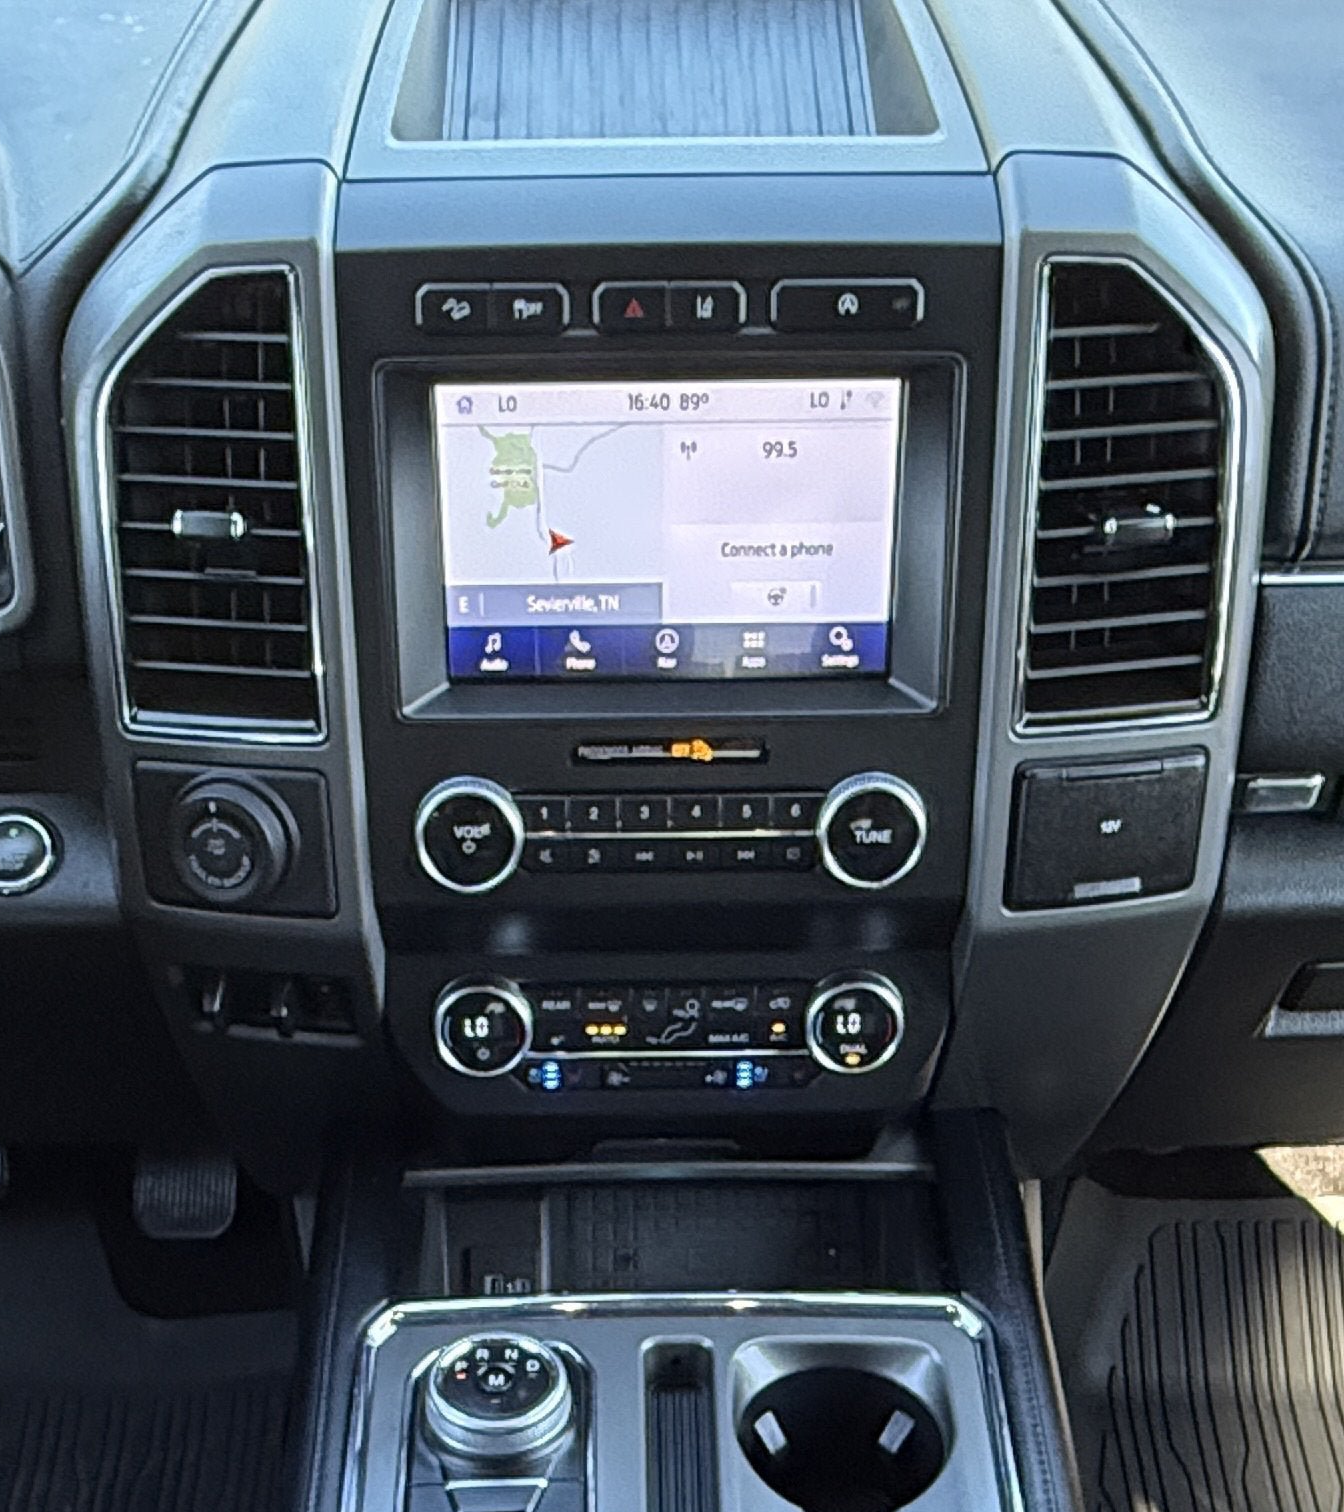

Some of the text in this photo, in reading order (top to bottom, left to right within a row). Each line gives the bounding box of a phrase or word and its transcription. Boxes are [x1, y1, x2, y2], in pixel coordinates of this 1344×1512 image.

[497, 396, 518, 413] LO
[628, 392, 671, 411] 16:40
[809, 391, 830, 408] LO
[762, 441, 798, 460] 99.5
[720, 541, 835, 560] Connect a phone
[458, 595, 470, 614] E
[540, 805, 549, 821] 1
[588, 805, 600, 821] 2
[640, 804, 651, 820] 3
[690, 803, 703, 819] 4
[741, 803, 753, 819] 5
[789, 802, 802, 818] 6
[854, 828, 894, 845] TUNE
[475, 1347, 490, 1361] R
[504, 1347, 519, 1361] N
[454, 1360, 470, 1373] P
[526, 1358, 541, 1373] D
[488, 1373, 506, 1387] M
